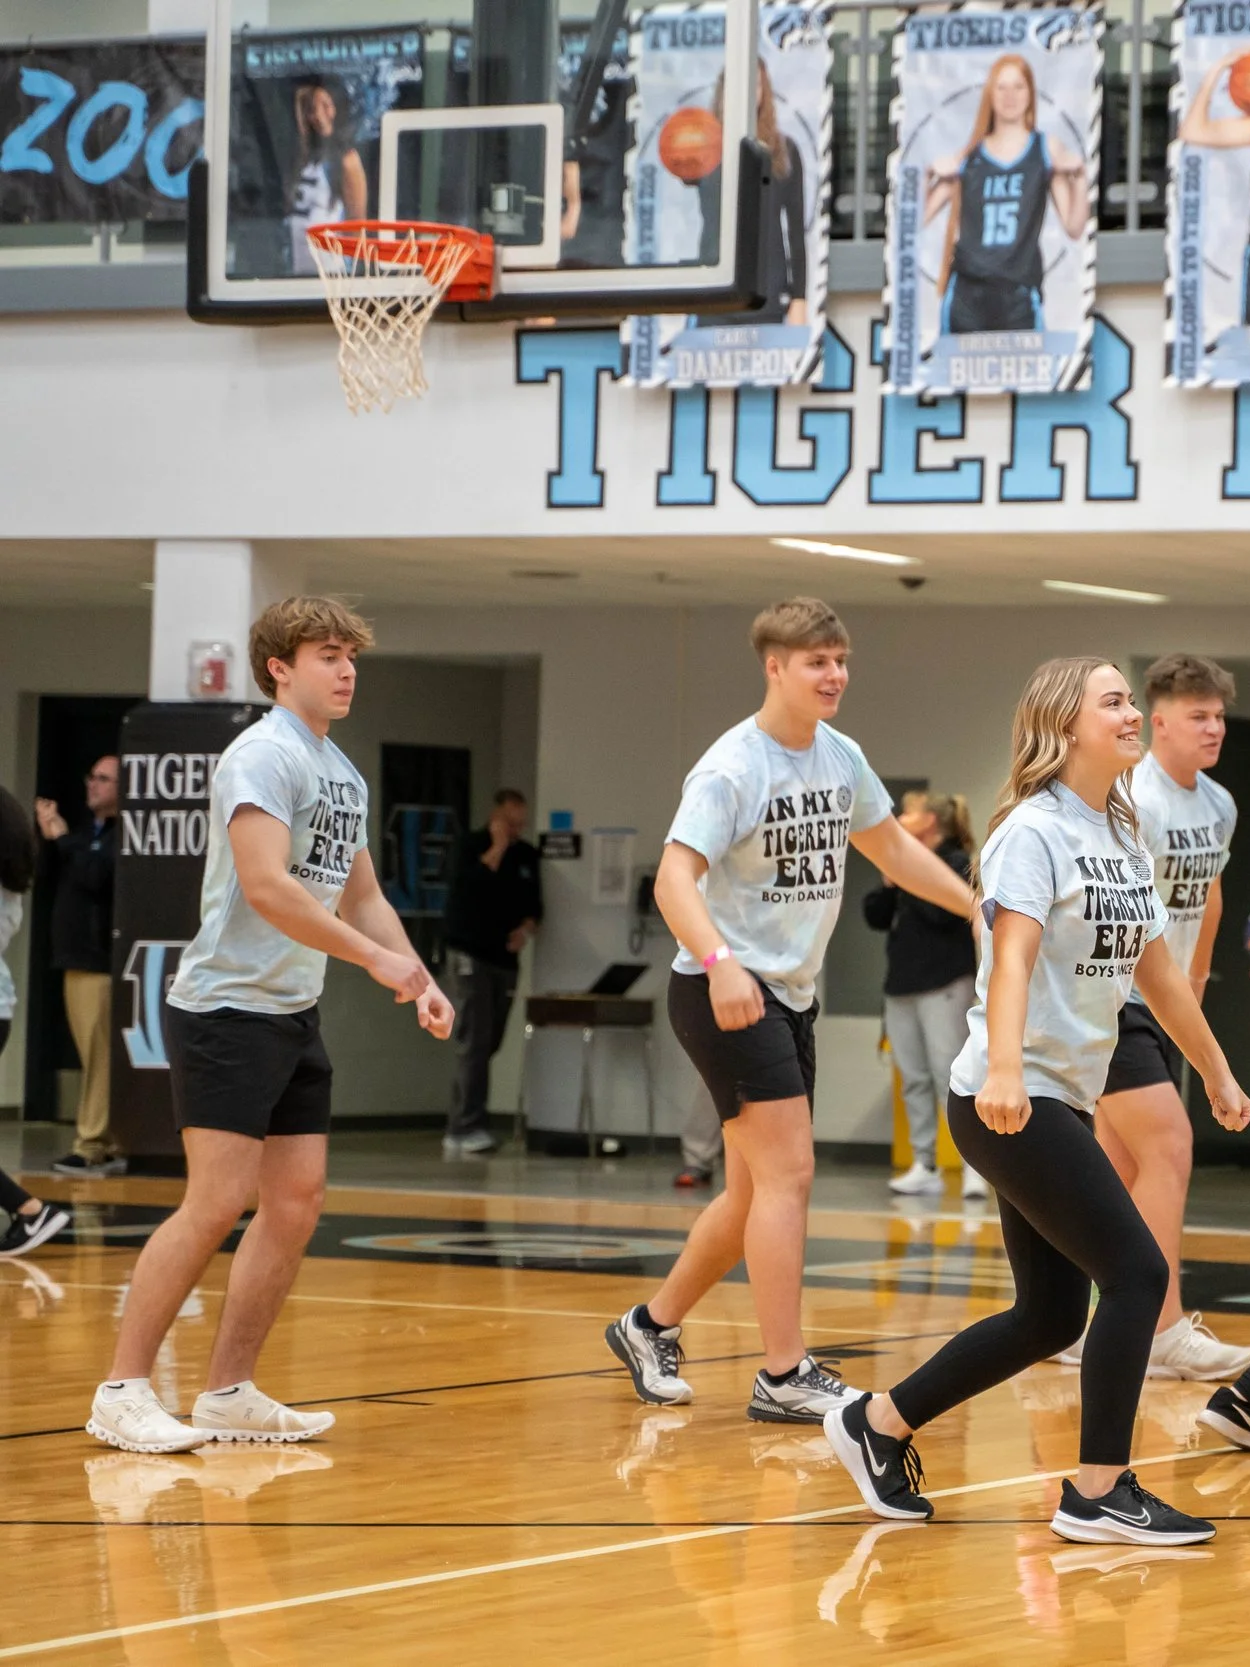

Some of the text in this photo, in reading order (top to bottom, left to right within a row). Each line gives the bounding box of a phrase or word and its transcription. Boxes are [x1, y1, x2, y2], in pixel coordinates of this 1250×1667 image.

[909, 16, 1028, 49] TIGERS
[983, 172, 1025, 199] IKE
[1185, 155, 1202, 192] ZOO
[981, 201, 1020, 247] 15
[1183, 198, 1200, 241] THE
[1182, 245, 1198, 274] TO
[677, 348, 798, 383] DAMERON
[951, 354, 1053, 386] BUCHER
[515, 311, 1139, 507] TIGER
[764, 788, 833, 824] IN MY
[120, 808, 210, 857] NATIO
[763, 817, 850, 858] TIGERETTE
[1166, 828, 1191, 850] IN
[305, 833, 348, 875] ERA
[773, 853, 837, 888] ERA
[289, 864, 323, 883] BOYS
[1090, 924, 1143, 960] ERA
[1075, 963, 1115, 978] BOYS
